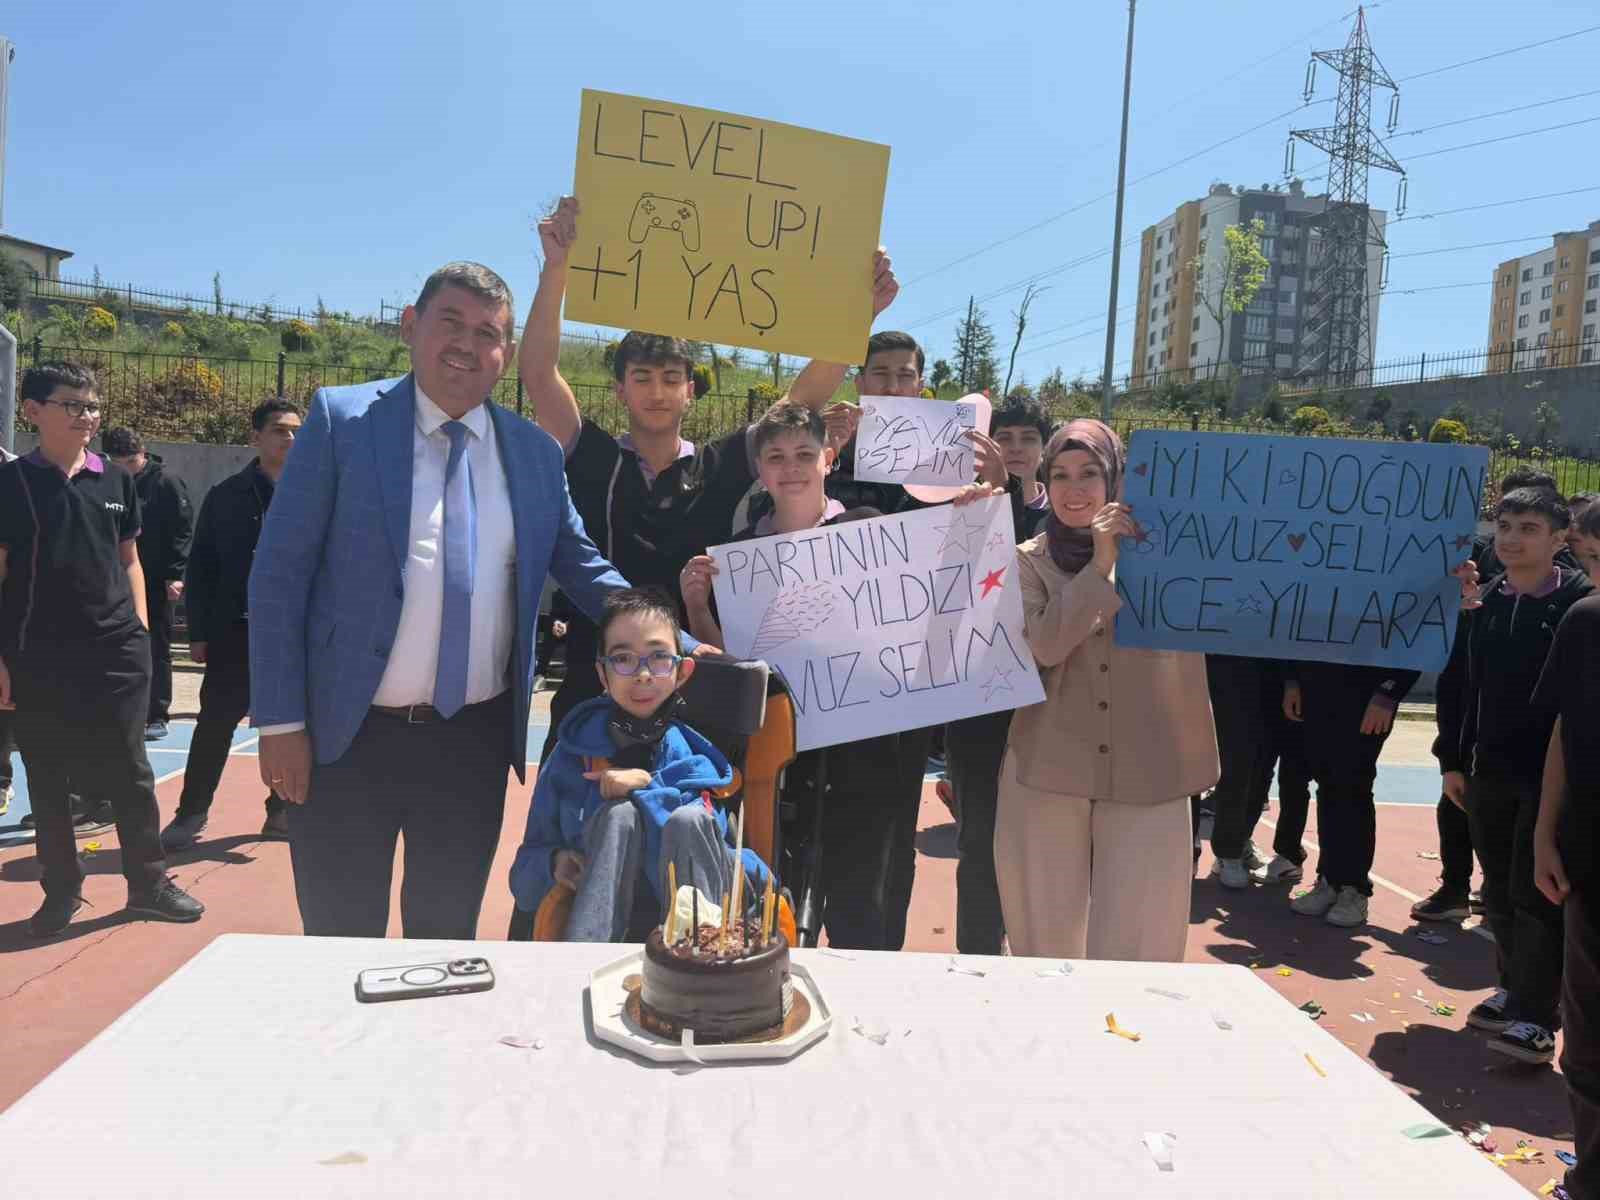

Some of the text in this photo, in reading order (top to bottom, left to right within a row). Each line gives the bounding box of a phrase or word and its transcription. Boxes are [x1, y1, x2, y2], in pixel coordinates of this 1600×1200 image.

[594, 103, 797, 190] LEVEL
[746, 193, 821, 260] UP!
[570, 246, 642, 310] +1
[681, 254, 778, 336] YAŞ
[1150, 440, 1200, 498] İYİ
[1297, 450, 1485, 526] DOĞDUN
[1160, 509, 1449, 577] YAVUZ SELİM
[1259, 579, 1449, 653] YILLARA
[773, 652, 870, 716] VUZ
